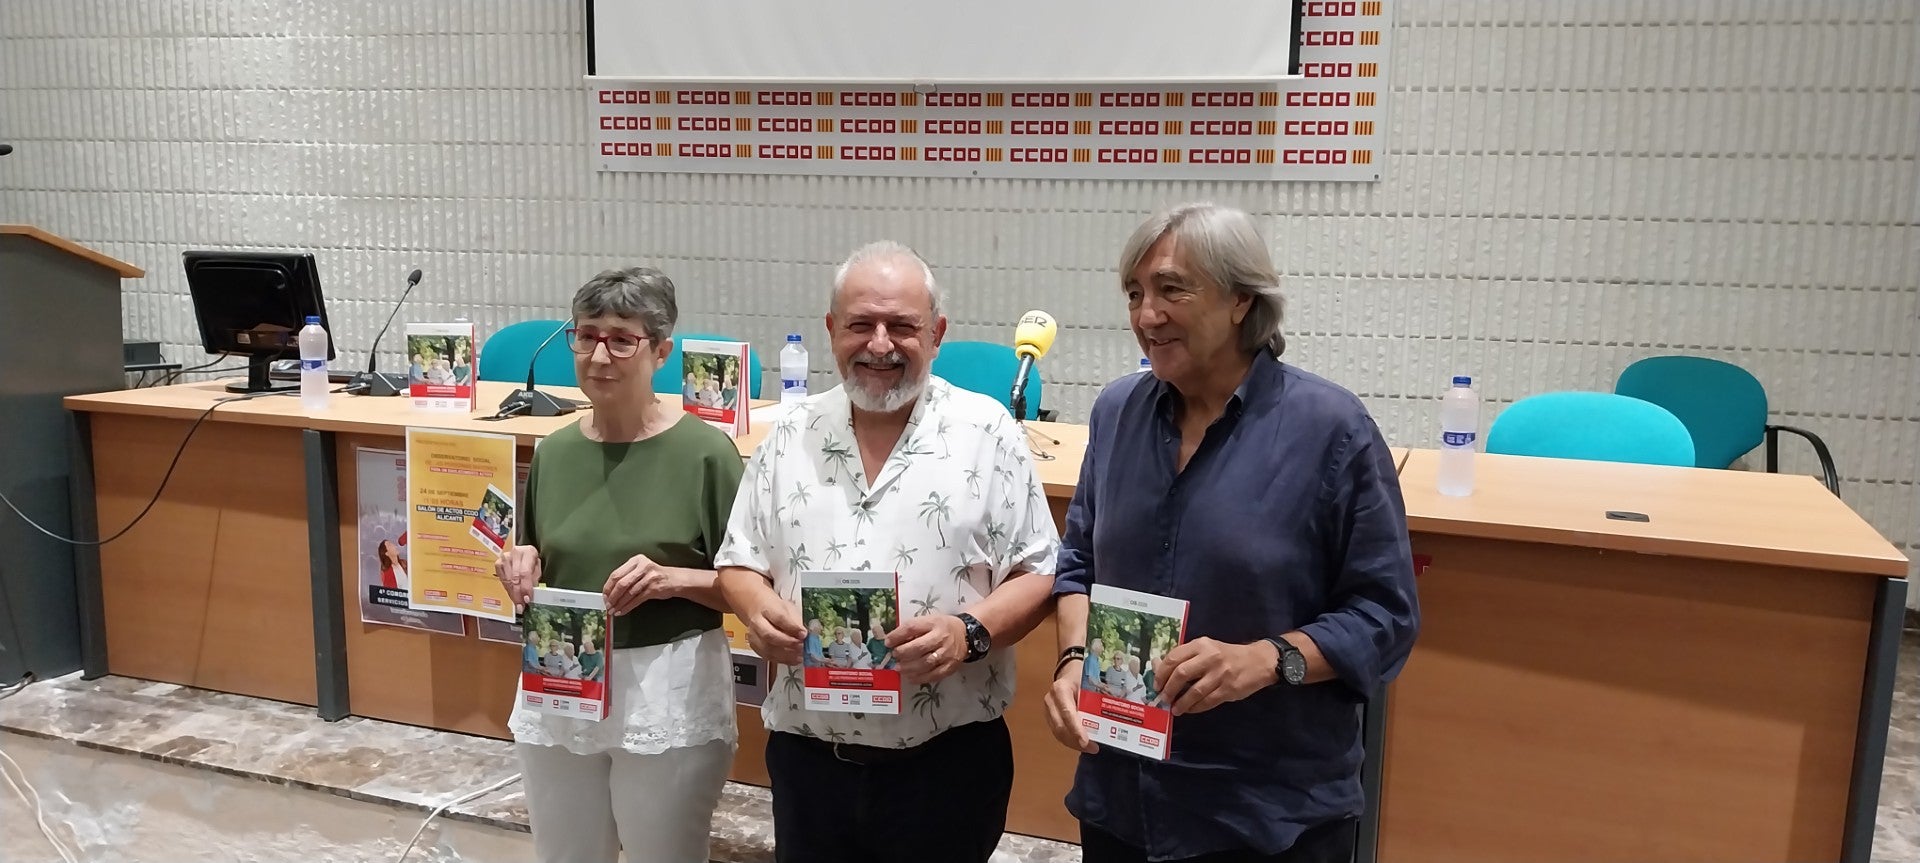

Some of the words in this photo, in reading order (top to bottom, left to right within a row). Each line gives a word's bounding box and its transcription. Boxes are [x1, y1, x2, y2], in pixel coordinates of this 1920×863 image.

[1299, 63, 1352, 78] COO
[599, 91, 650, 104] CCOO
[677, 91, 730, 104] CCOO
[758, 92, 812, 105] CCOO
[841, 92, 896, 106] CCOO
[926, 93, 981, 107] CCOO
[1012, 93, 1069, 107] CCOO
[1100, 93, 1160, 107] CCOO
[1192, 92, 1254, 107] CCOO
[1286, 92, 1350, 106] CCOO
[600, 117, 651, 130] CCOO
[678, 117, 730, 131] CCOO
[758, 118, 812, 132] CCOO
[841, 119, 895, 133] CCOO
[925, 120, 981, 134] CCOO
[1011, 121, 1068, 134] CCOO
[1099, 121, 1159, 135] CCOO
[1190, 121, 1252, 135] CCOO
[1285, 121, 1348, 135] CCOO
[601, 143, 652, 156] CCOO
[679, 144, 731, 157] CCOO
[759, 145, 812, 159] CCOO
[841, 146, 895, 160] CCOO
[925, 147, 980, 161] CCOO
[1010, 148, 1067, 162] CCOO
[1098, 149, 1157, 163] CCOO
[1189, 149, 1250, 163] CCOO
[1283, 150, 1346, 164] CCOO
